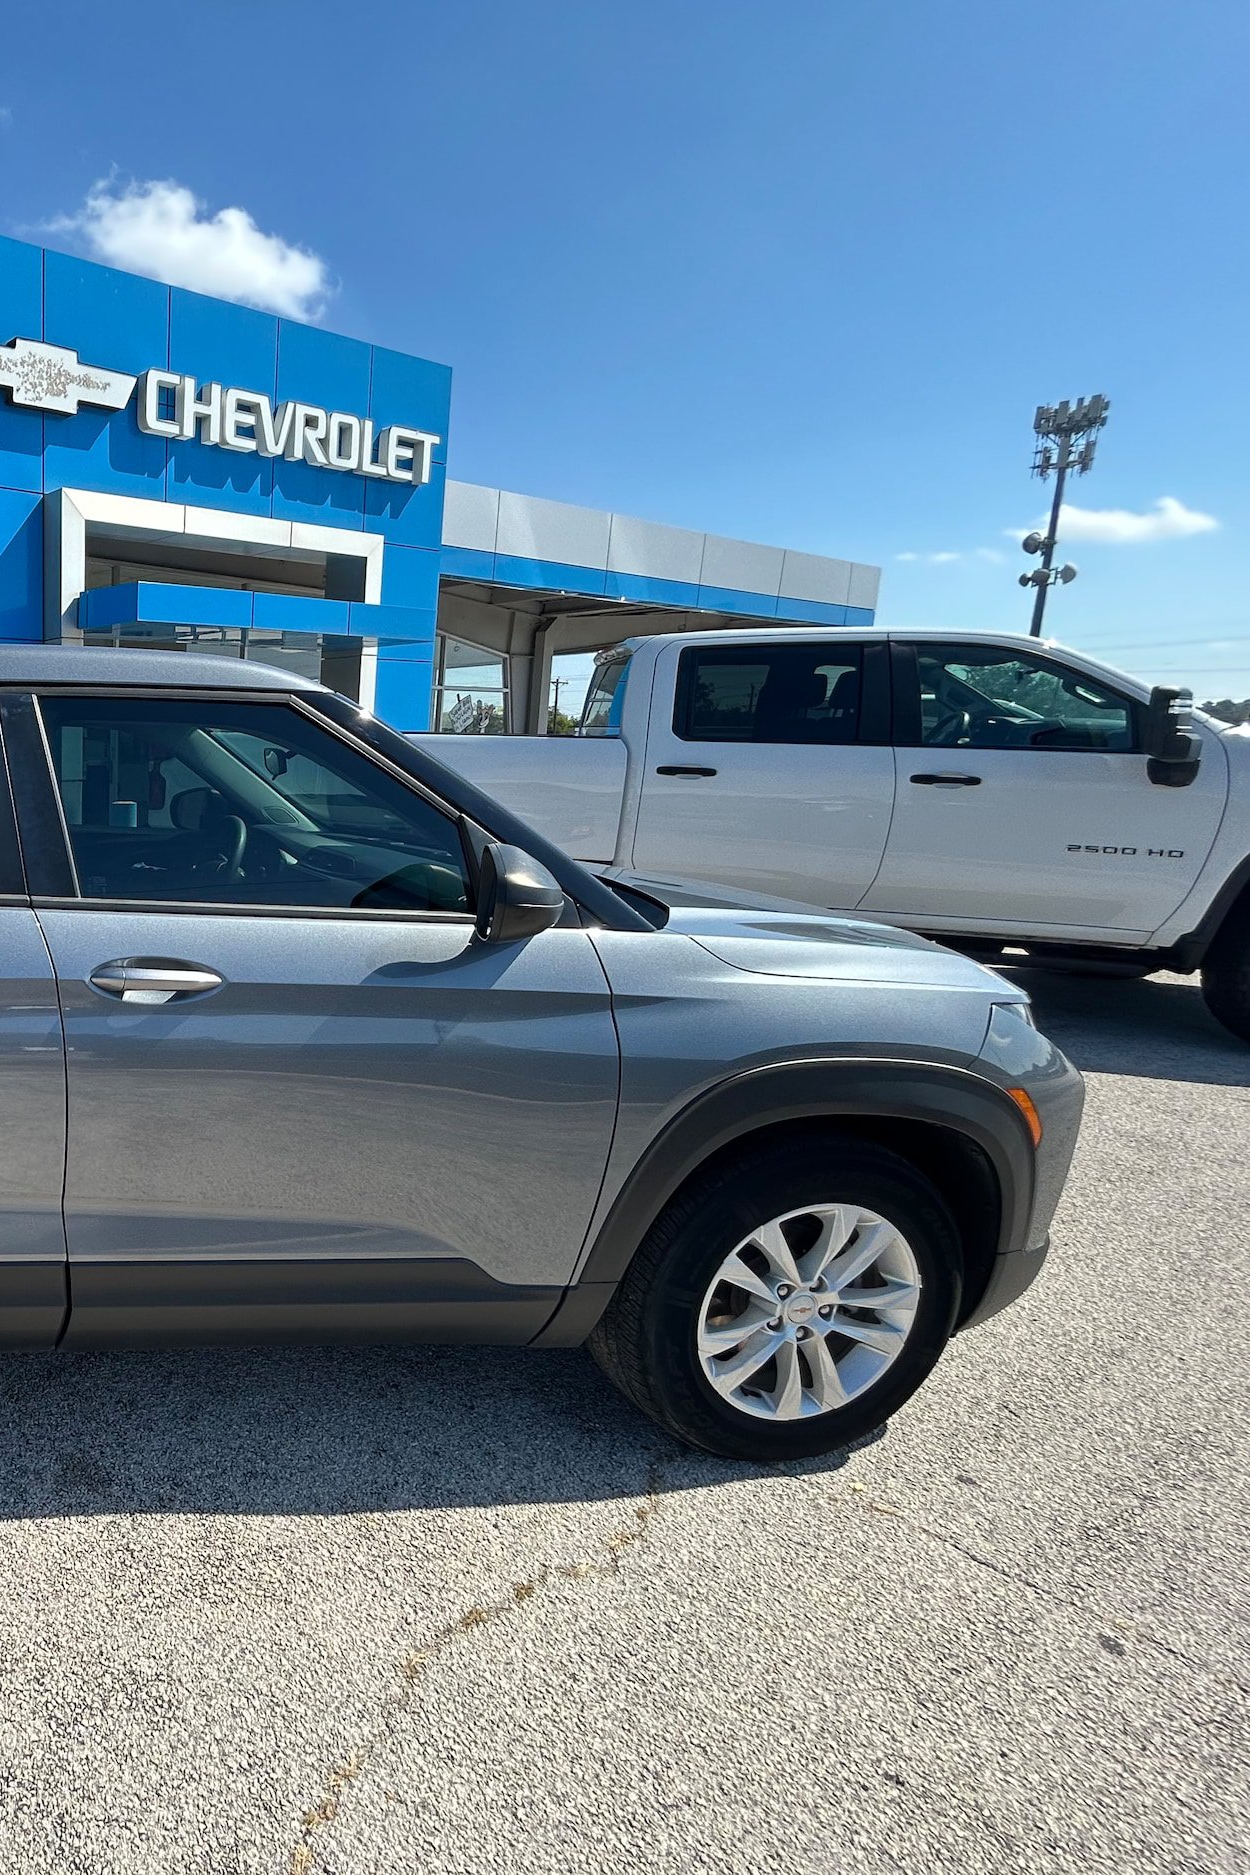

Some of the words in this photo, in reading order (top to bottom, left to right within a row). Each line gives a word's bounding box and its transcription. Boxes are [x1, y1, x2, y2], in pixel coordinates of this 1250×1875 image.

[138, 367, 441, 485] CHEVROLET
[1065, 844, 1137, 856] 2500
[1147, 848, 1185, 858] HD
